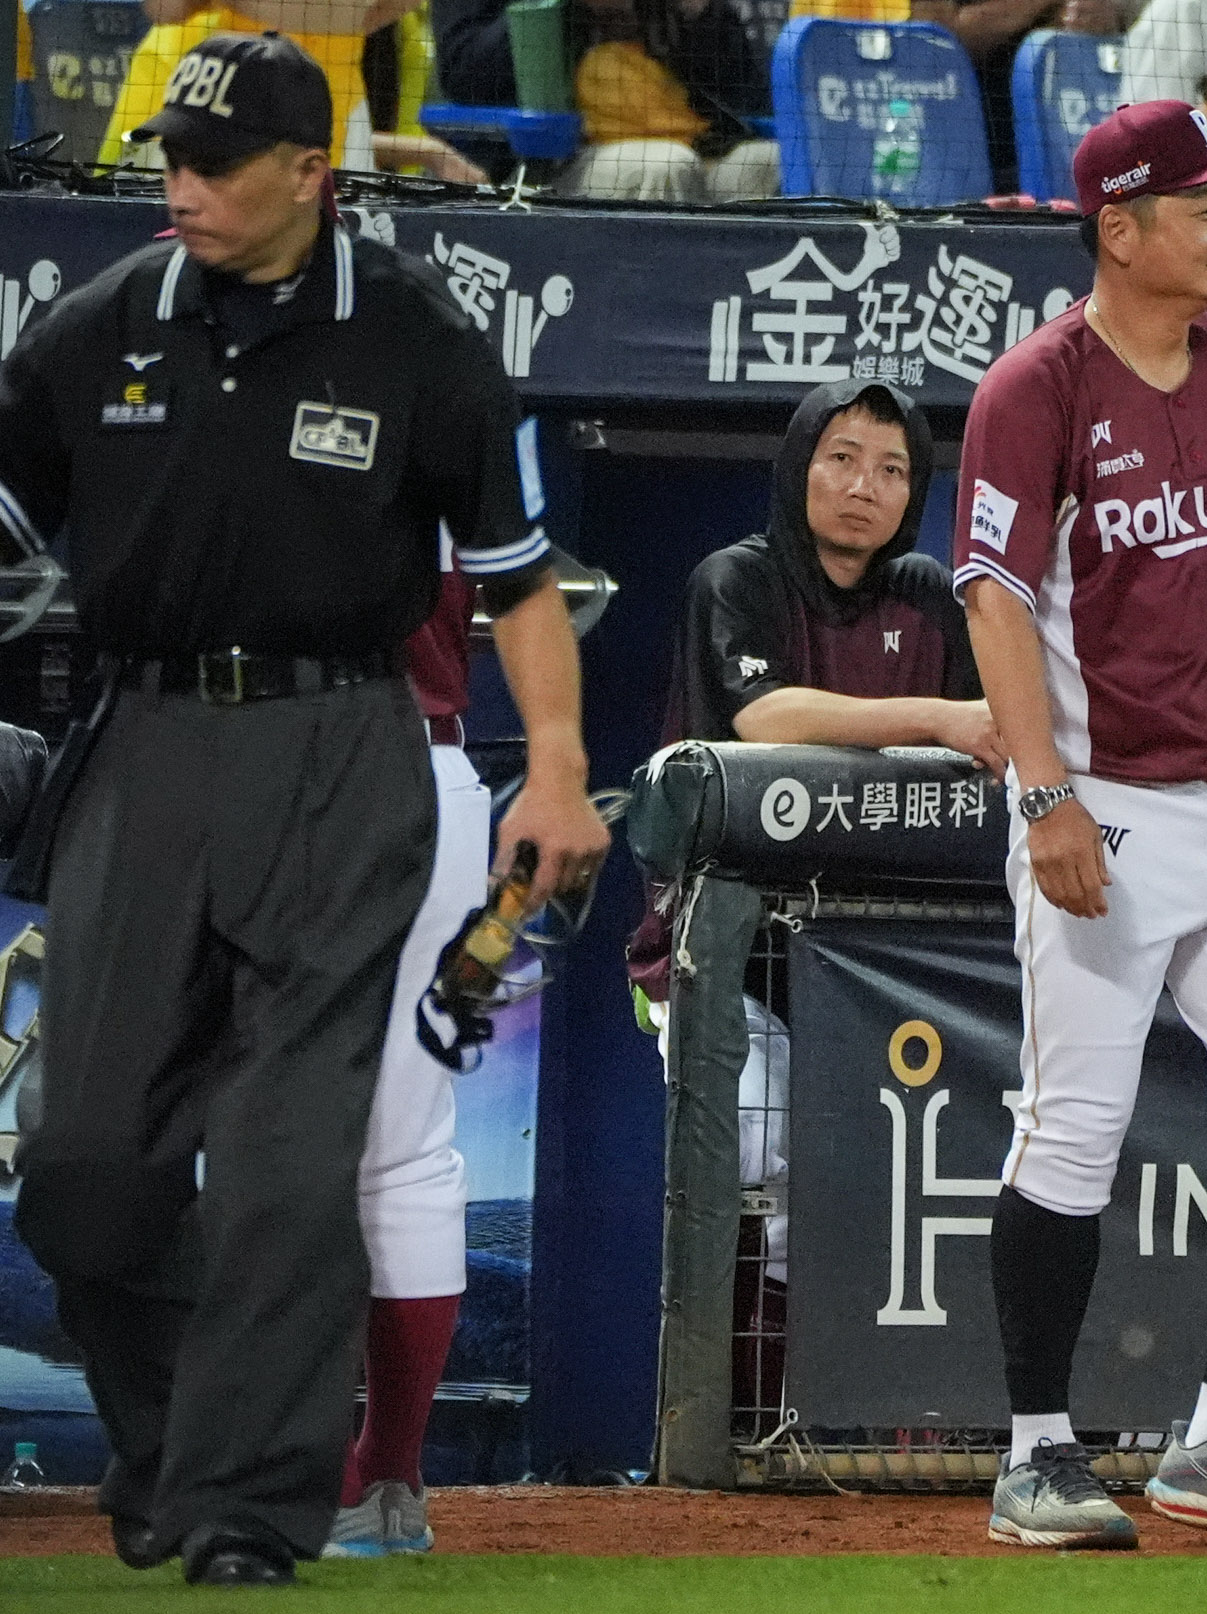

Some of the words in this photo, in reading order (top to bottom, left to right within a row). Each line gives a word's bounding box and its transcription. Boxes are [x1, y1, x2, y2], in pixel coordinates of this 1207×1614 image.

[1101, 161, 1152, 195] tigerair
[816, 779, 987, 833] 大學眼科
